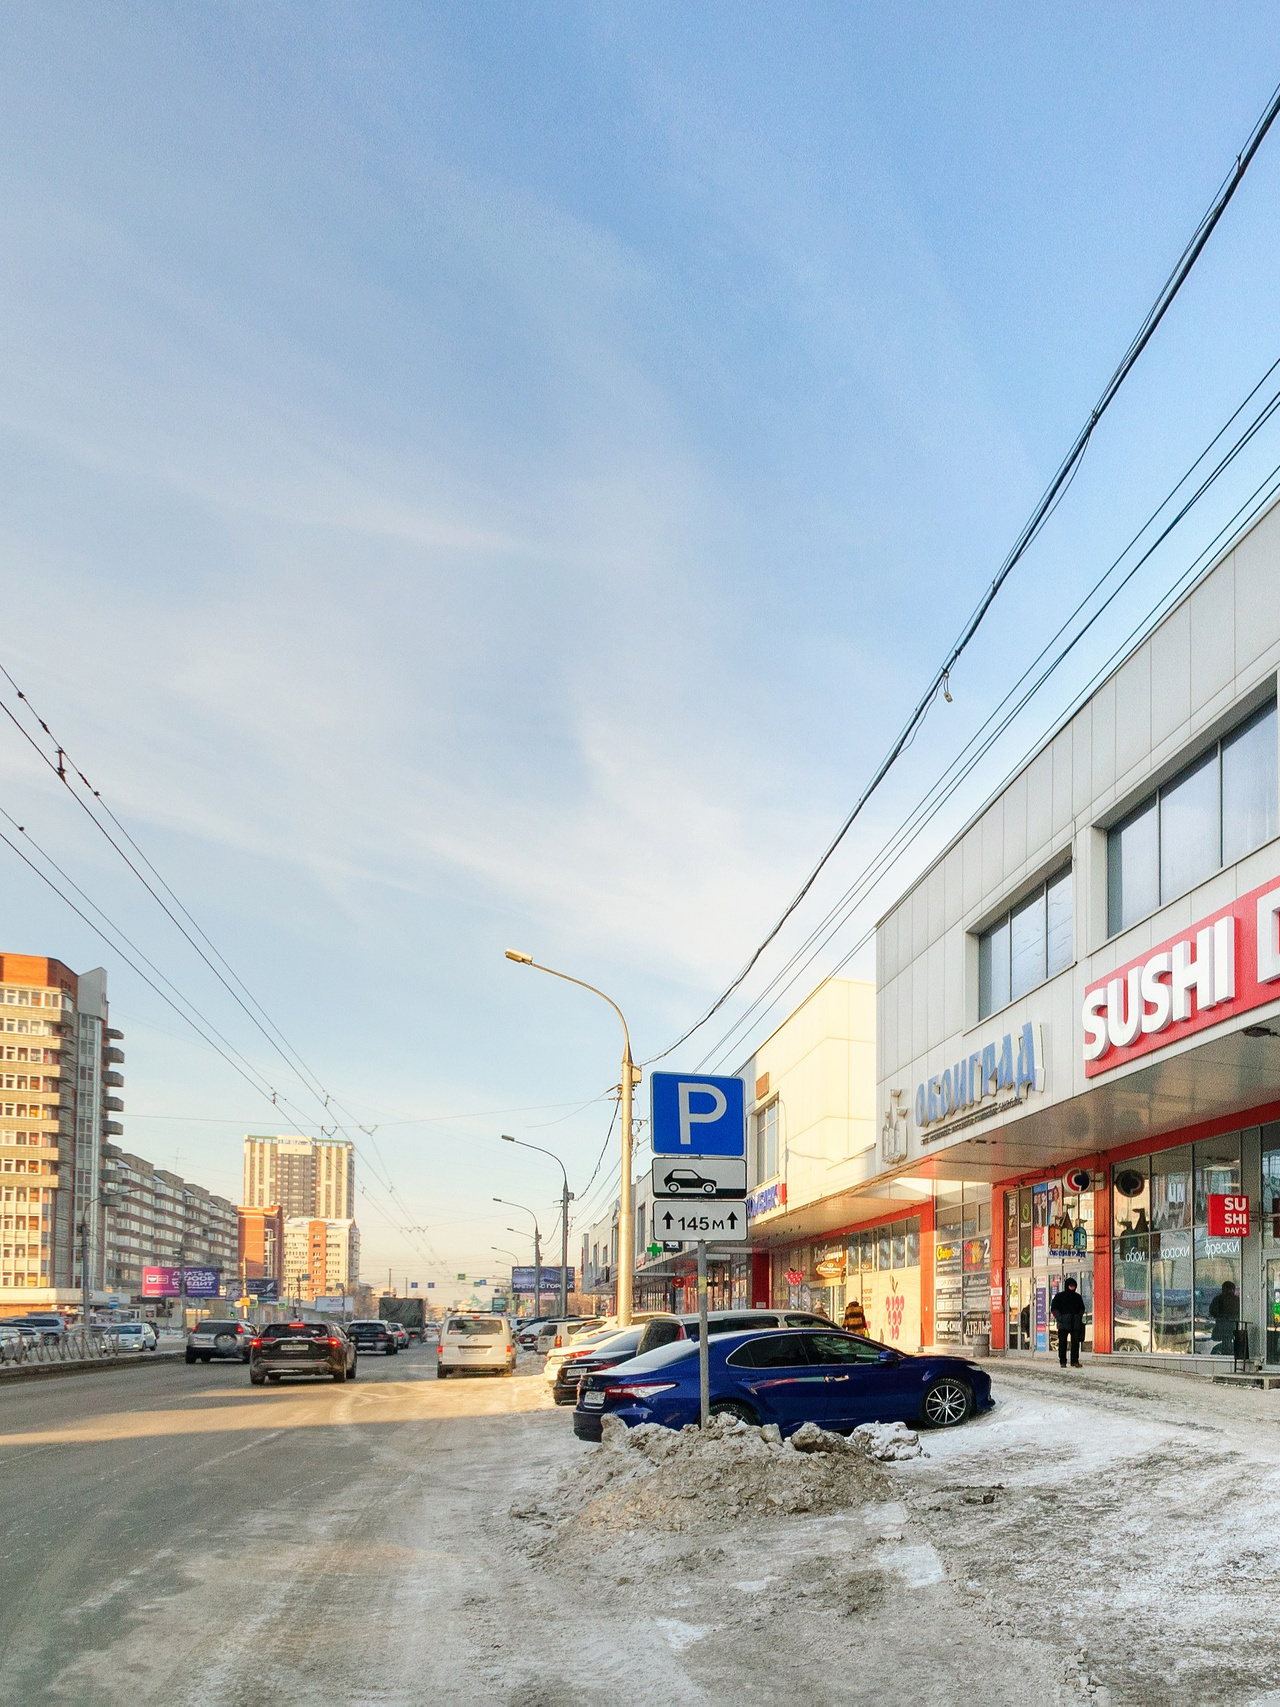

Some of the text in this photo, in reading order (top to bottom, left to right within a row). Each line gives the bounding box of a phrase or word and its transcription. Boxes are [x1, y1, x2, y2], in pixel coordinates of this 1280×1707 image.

[1082, 915, 1236, 1061] SUSHI
[916, 1021, 1045, 1127] ОБОИГРАД
[678, 1082, 728, 1145] P
[1224, 1197, 1247, 1211] SU
[677, 1216, 710, 1231] 145
[1224, 1213, 1247, 1225] SHI
[1125, 1246, 1146, 1262] обои
[1161, 1246, 1191, 1260] краски
[1205, 1238, 1240, 1260] фрески
